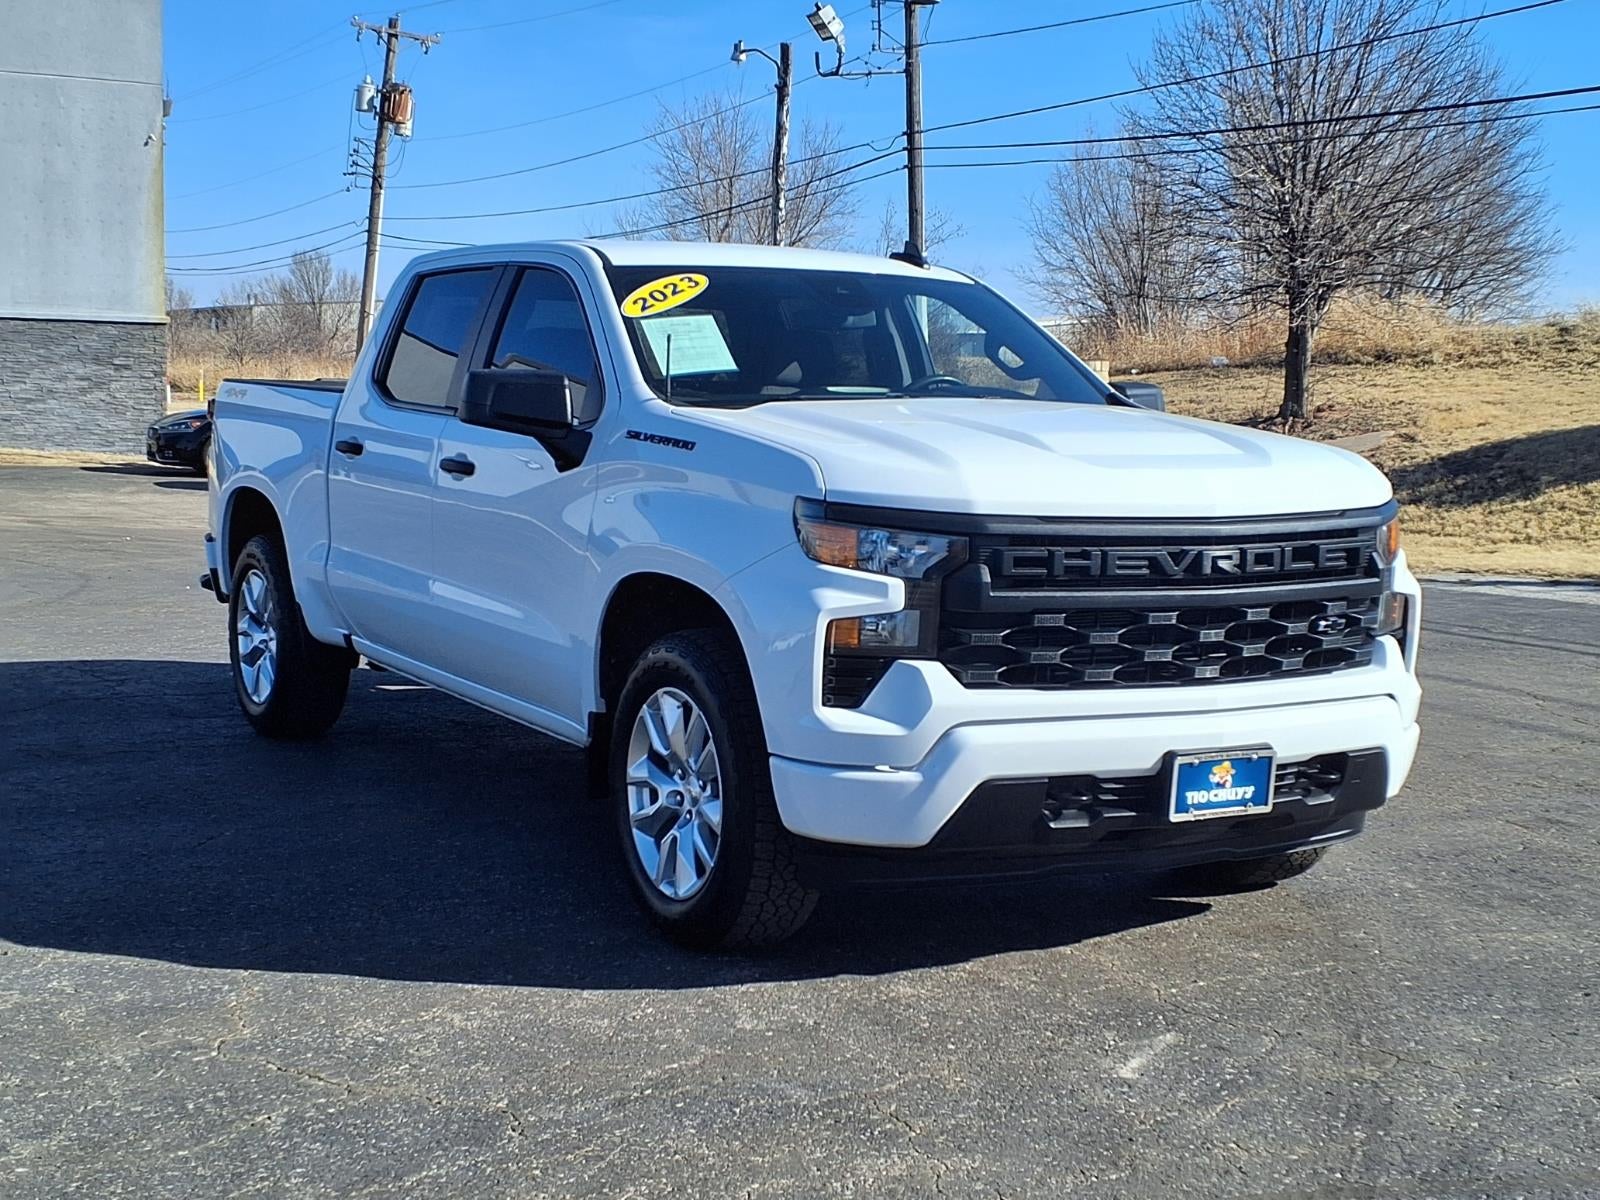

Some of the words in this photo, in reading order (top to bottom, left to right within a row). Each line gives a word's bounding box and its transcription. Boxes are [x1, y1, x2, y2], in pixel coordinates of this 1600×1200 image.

[632, 276, 700, 312] 2023
[624, 429, 697, 452] SILVERADO
[1001, 541, 1377, 577] CHEVROLET
[1185, 789, 1208, 805] TIO
[1209, 785, 1256, 802] CHUY'S
